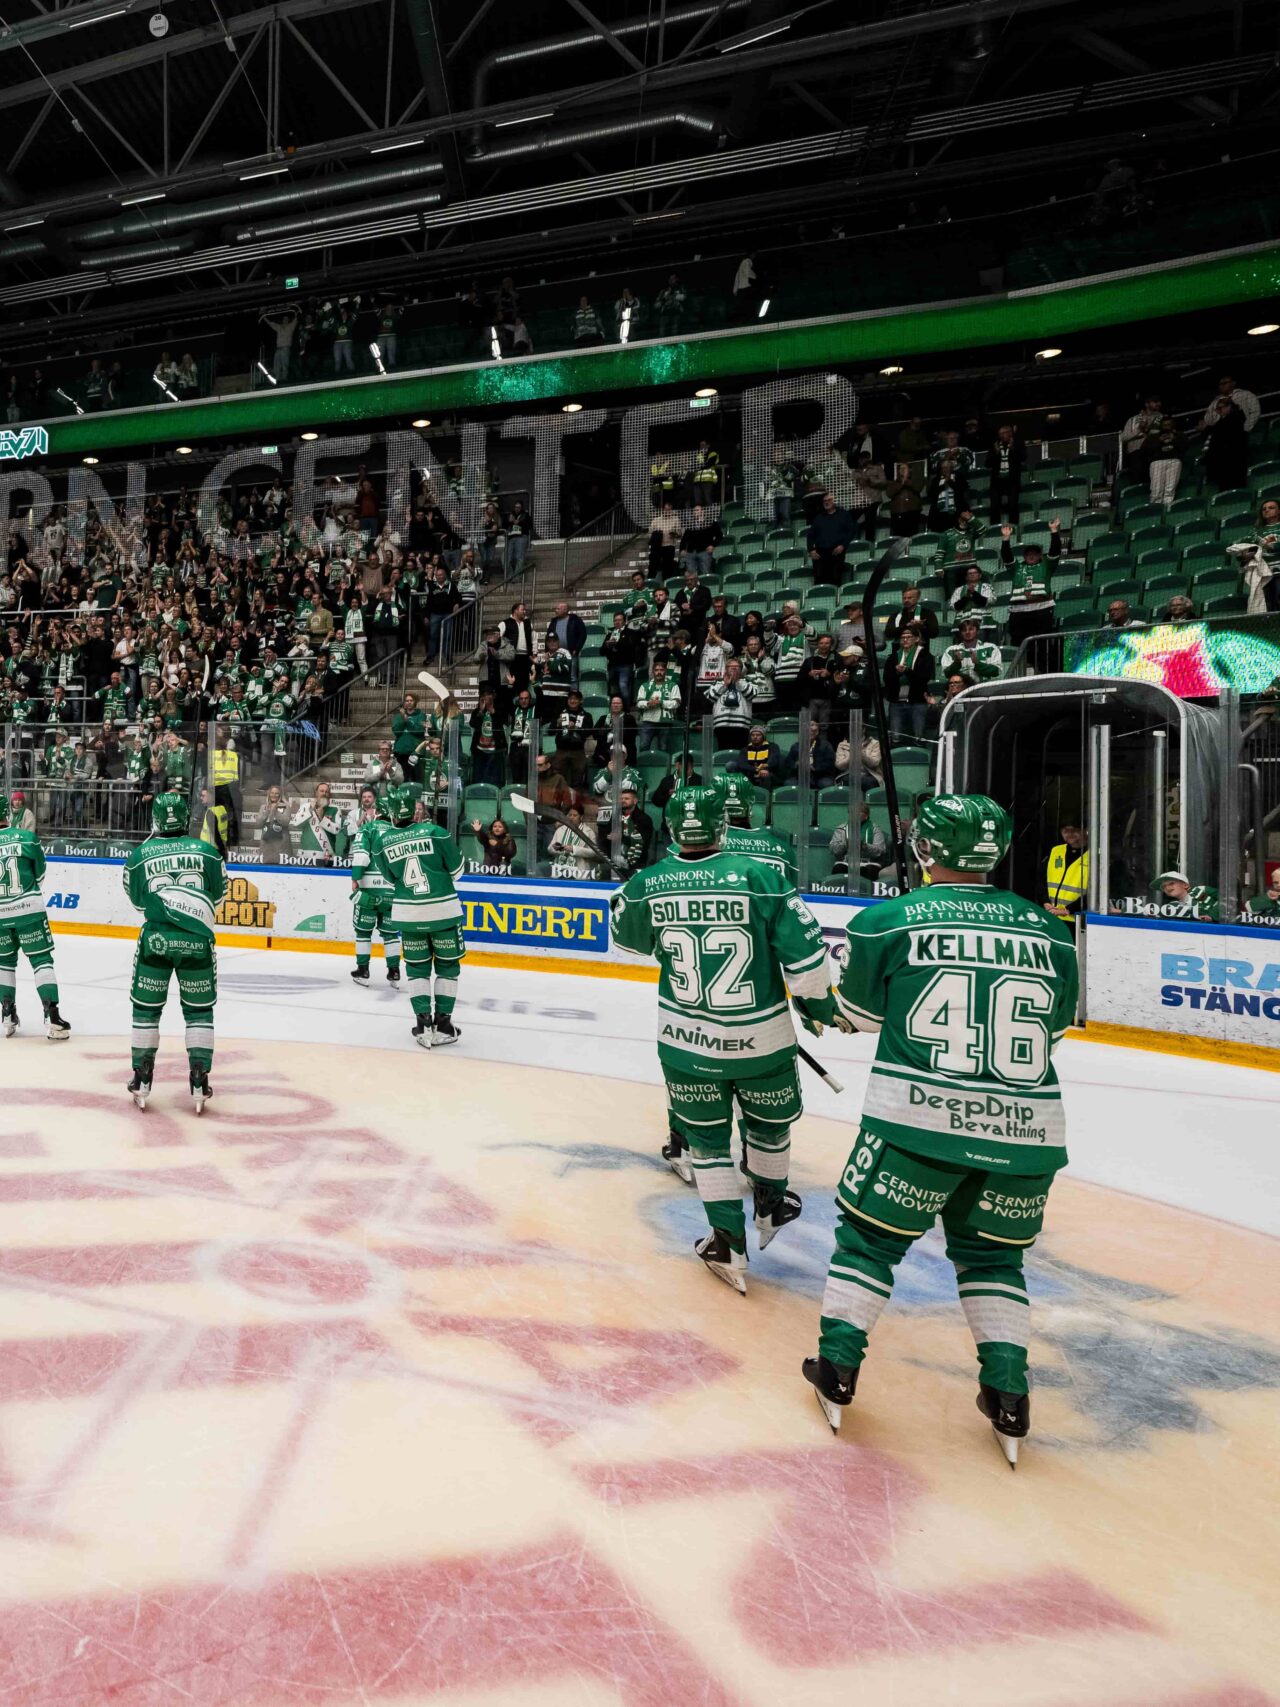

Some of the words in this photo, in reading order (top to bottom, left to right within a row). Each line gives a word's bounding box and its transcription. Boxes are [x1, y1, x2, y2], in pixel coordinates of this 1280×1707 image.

[196, 372, 866, 572] CENTER
[684, 802, 696, 810] 32
[981, 819, 996, 831] 46
[64, 843, 98, 858] Boozt
[227, 850, 265, 864] Boozt
[386, 840, 432, 862] CLURMAN
[146, 857, 203, 878] KUHLMAN
[279, 853, 317, 866] Boozt
[402, 855, 431, 896] 4
[469, 862, 513, 877] Boozt
[551, 863, 597, 880] Boozt
[644, 870, 716, 888] BRÄNNBORN
[645, 880, 716, 894] FASTIGHETER
[811, 882, 845, 894] Boozt
[46, 893, 81, 909] AB
[904, 900, 1014, 917] BRÄNNBORN
[1124, 896, 1200, 920] Boozt
[652, 899, 745, 924] SOLBERG
[907, 911, 1014, 924] FASTIGHETER
[463, 900, 603, 941] INERT
[917, 933, 1051, 972] KELLMAN
[659, 925, 755, 1011] 32
[906, 967, 1056, 1087] 46
[676, 1091, 723, 1104] NOVUM
[739, 1084, 794, 1100] CERNITOL
[750, 1093, 795, 1107] NOVUM
[910, 1083, 1035, 1126] DeepDrip
[950, 1112, 1047, 1143] Bevattning
